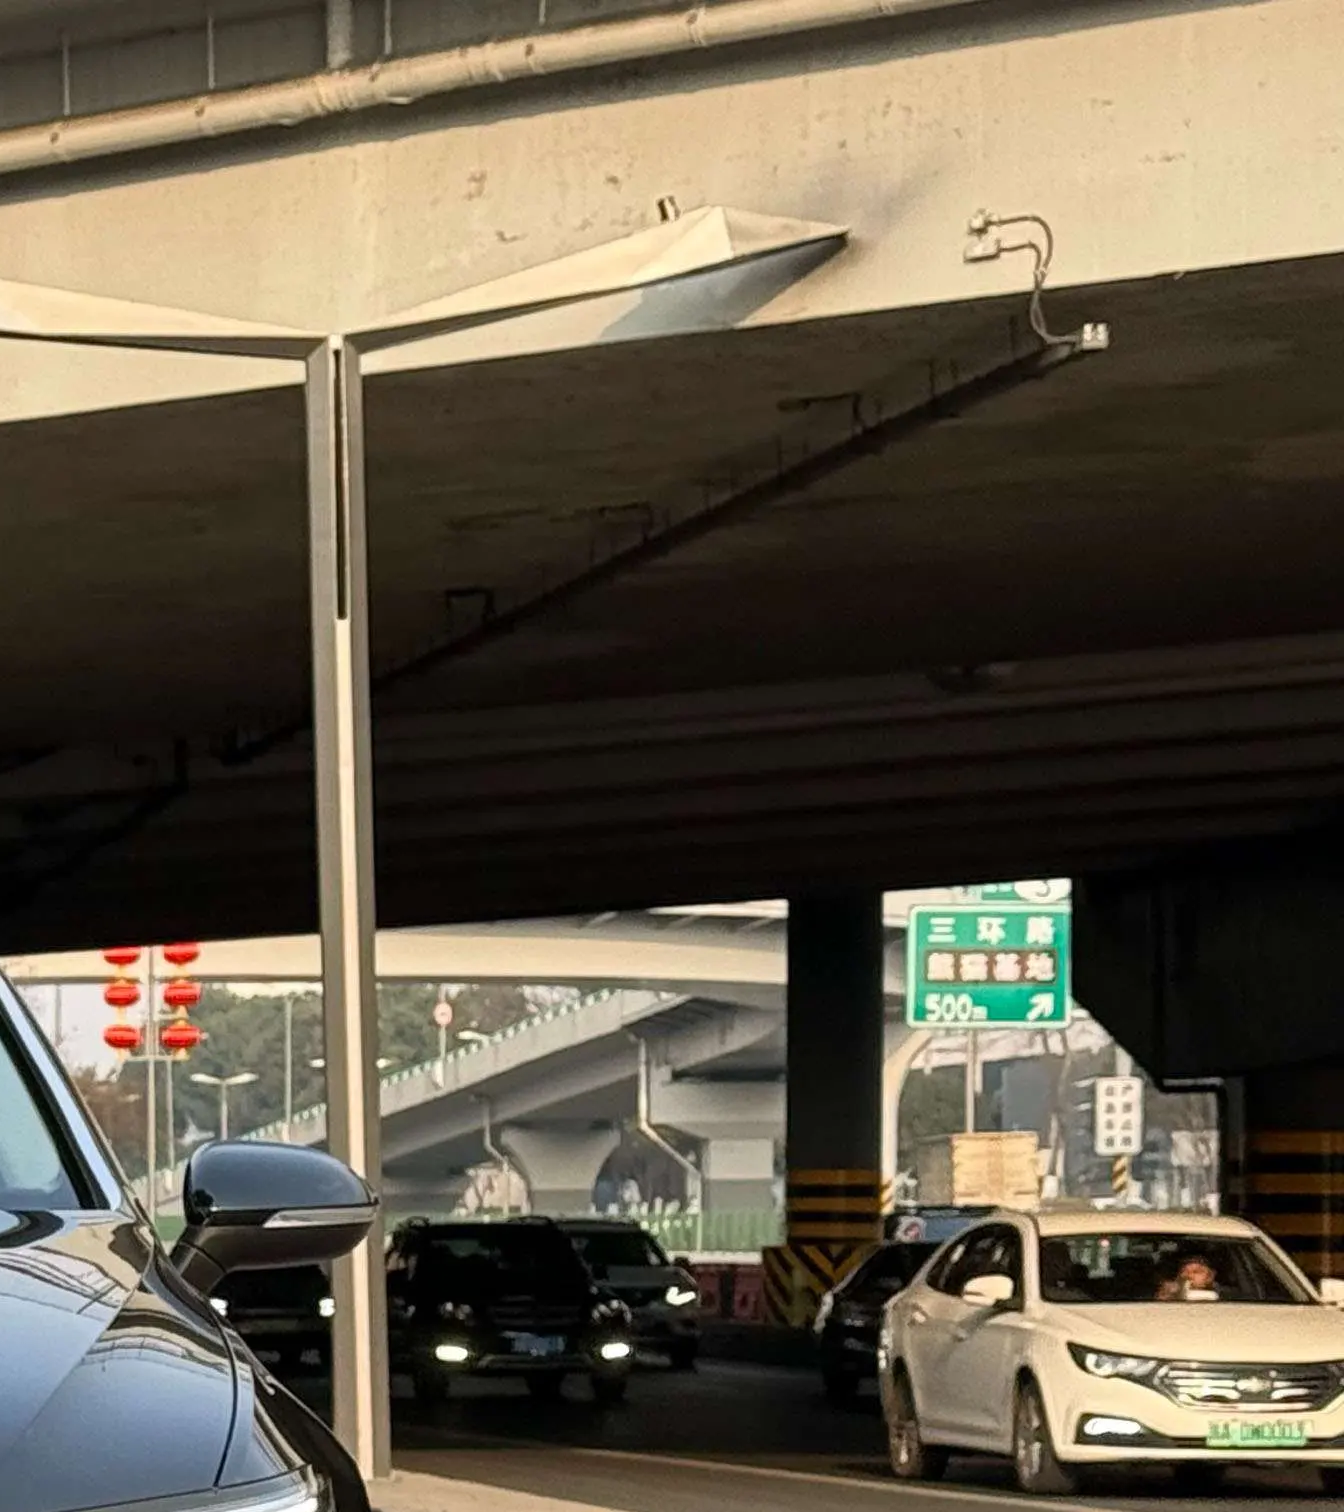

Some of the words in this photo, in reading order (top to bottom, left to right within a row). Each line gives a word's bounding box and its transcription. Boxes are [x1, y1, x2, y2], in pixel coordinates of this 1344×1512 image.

[927, 916, 1055, 945] 三环路
[924, 993, 988, 1021] 500m
